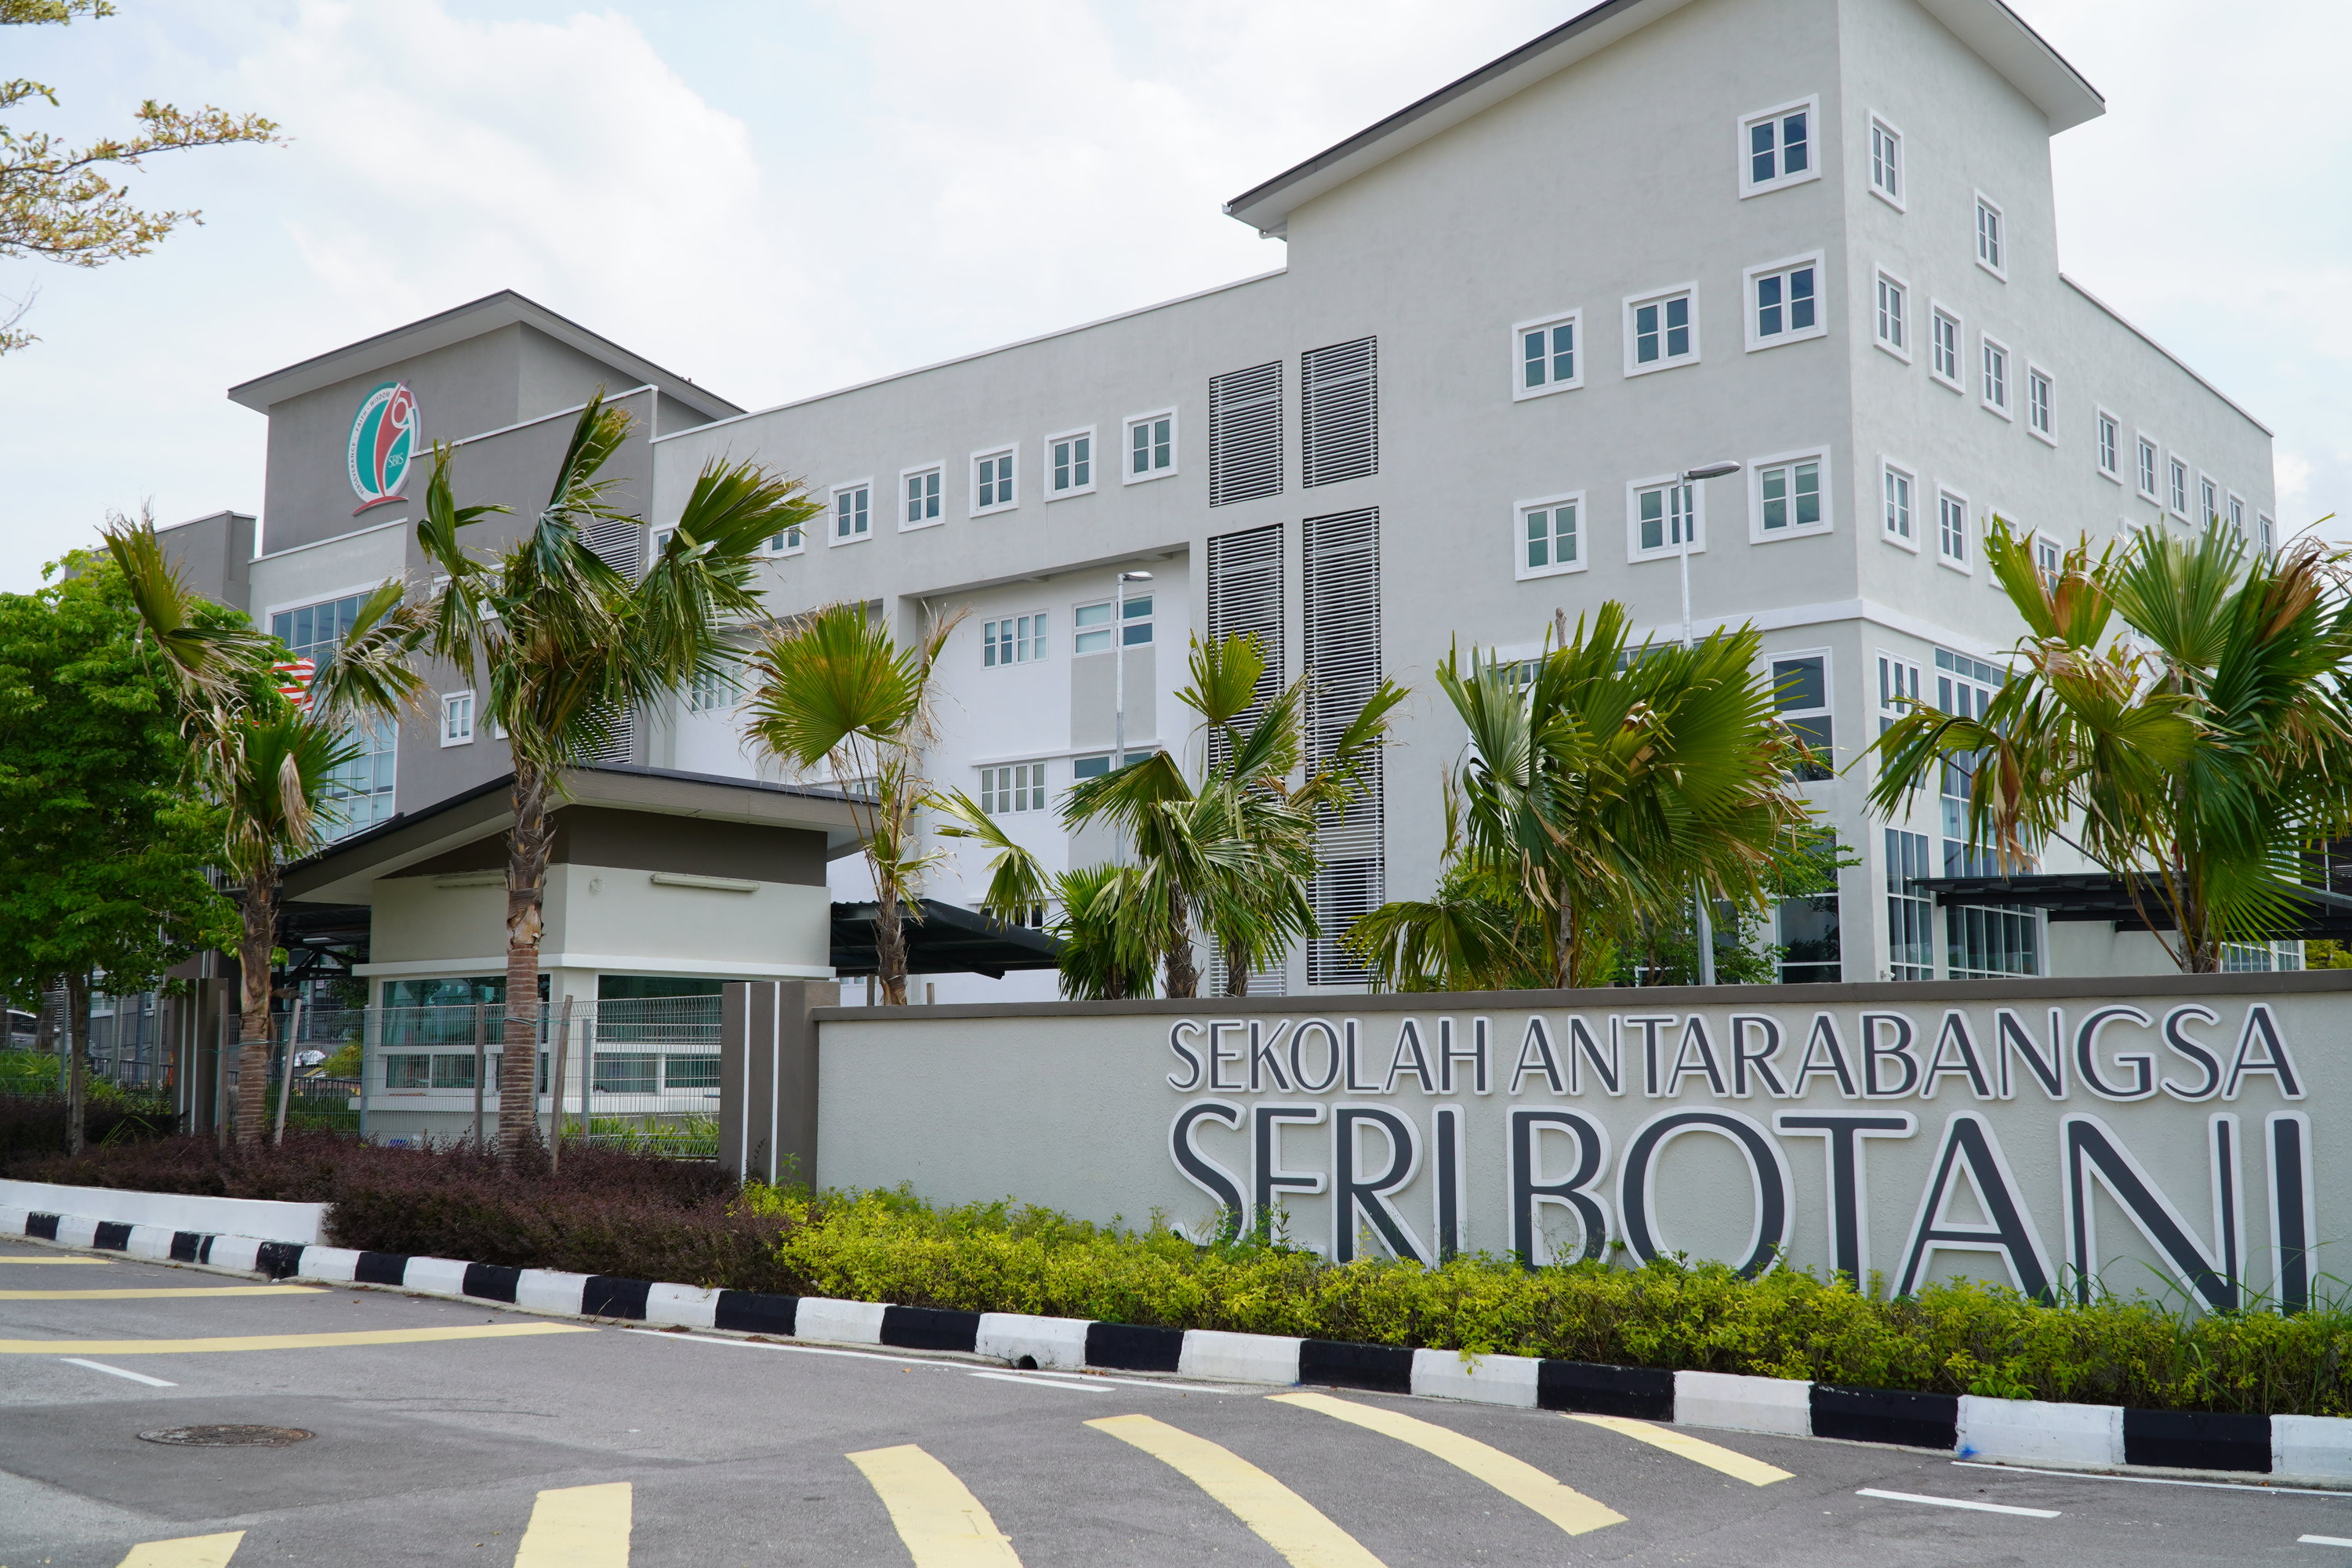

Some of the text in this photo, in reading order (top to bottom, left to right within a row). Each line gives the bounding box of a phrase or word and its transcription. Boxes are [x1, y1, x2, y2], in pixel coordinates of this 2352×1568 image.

[355, 410, 367, 432] FAITH
[369, 390, 390, 406] WISDOM
[388, 452, 404, 468] SBIS
[1166, 1003, 2307, 1102] SEKOLAH ANTARABANGSA
[1168, 1098, 2319, 1319] SERI BOTANI
